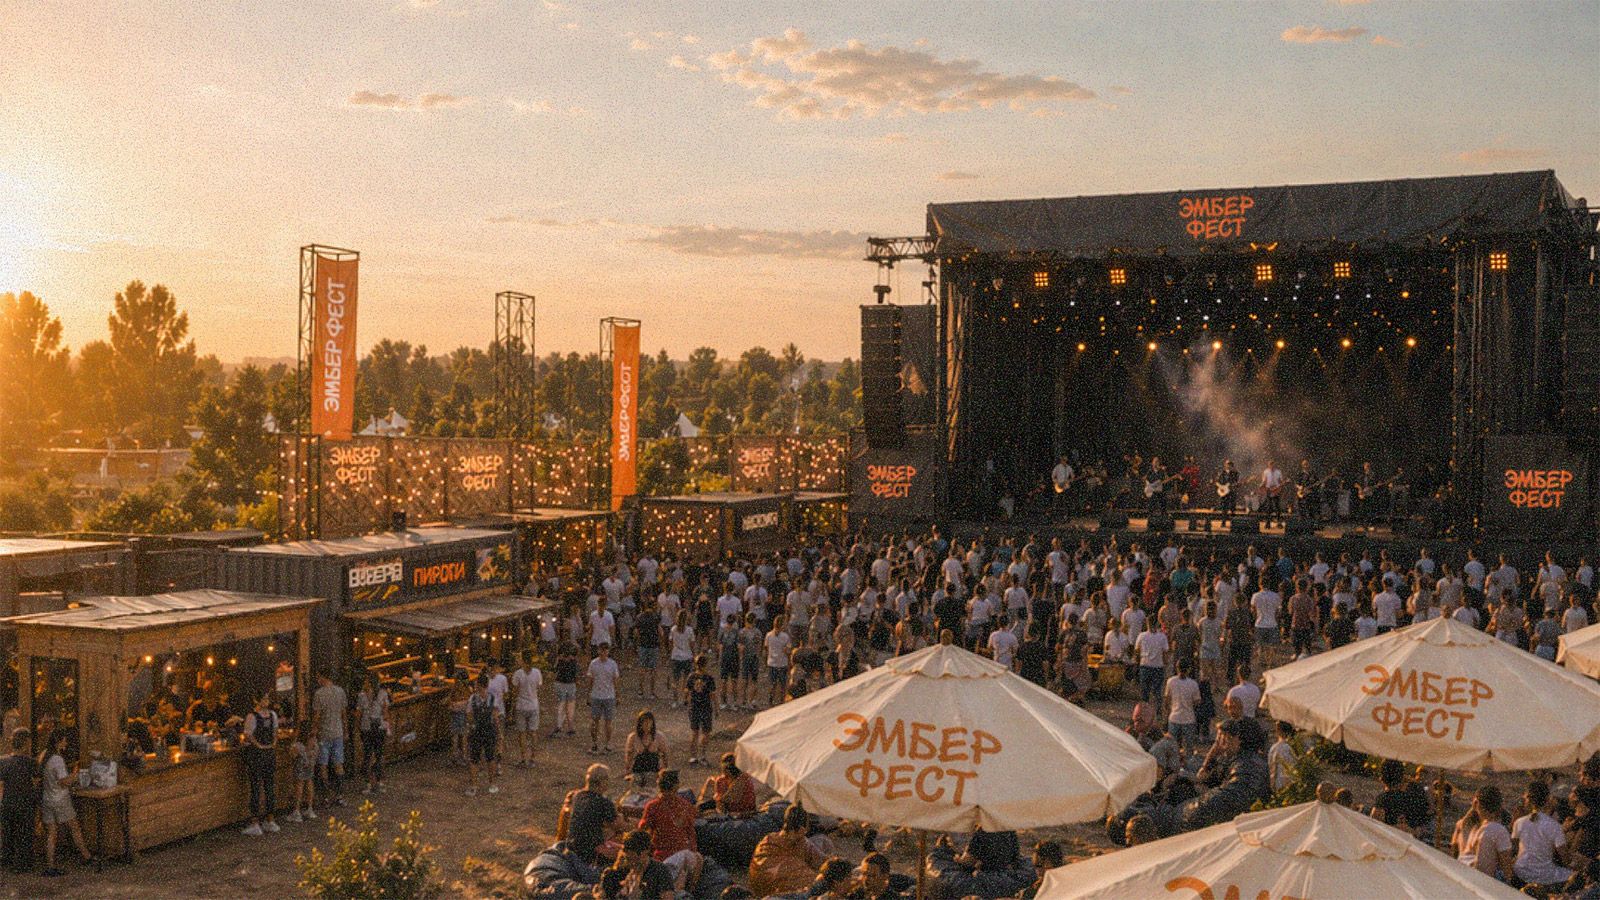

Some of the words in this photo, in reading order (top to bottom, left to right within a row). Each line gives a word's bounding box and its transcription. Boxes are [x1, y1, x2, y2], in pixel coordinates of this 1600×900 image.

[1179, 195, 1255, 218] ЭМБЕР
[1186, 218, 1246, 239] ФЕСТ
[326, 277, 346, 336] ФЕСТ
[324, 340, 343, 413] ЭМБЕР
[336, 466, 376, 484] ФЕСТ
[867, 464, 917, 482] ЭМБЕР
[1504, 469, 1574, 489] ЭМБЕР
[871, 481, 912, 499] ФЕСТ
[1508, 489, 1565, 508] ФЕСТ
[413, 560, 465, 588] ПИРОГИ
[1361, 663, 1495, 708] ЭМБЕР
[1371, 702, 1475, 741] ФЕСТ
[832, 712, 1002, 765] ЭМБЕР
[845, 758, 978, 806] ФЕСТ
